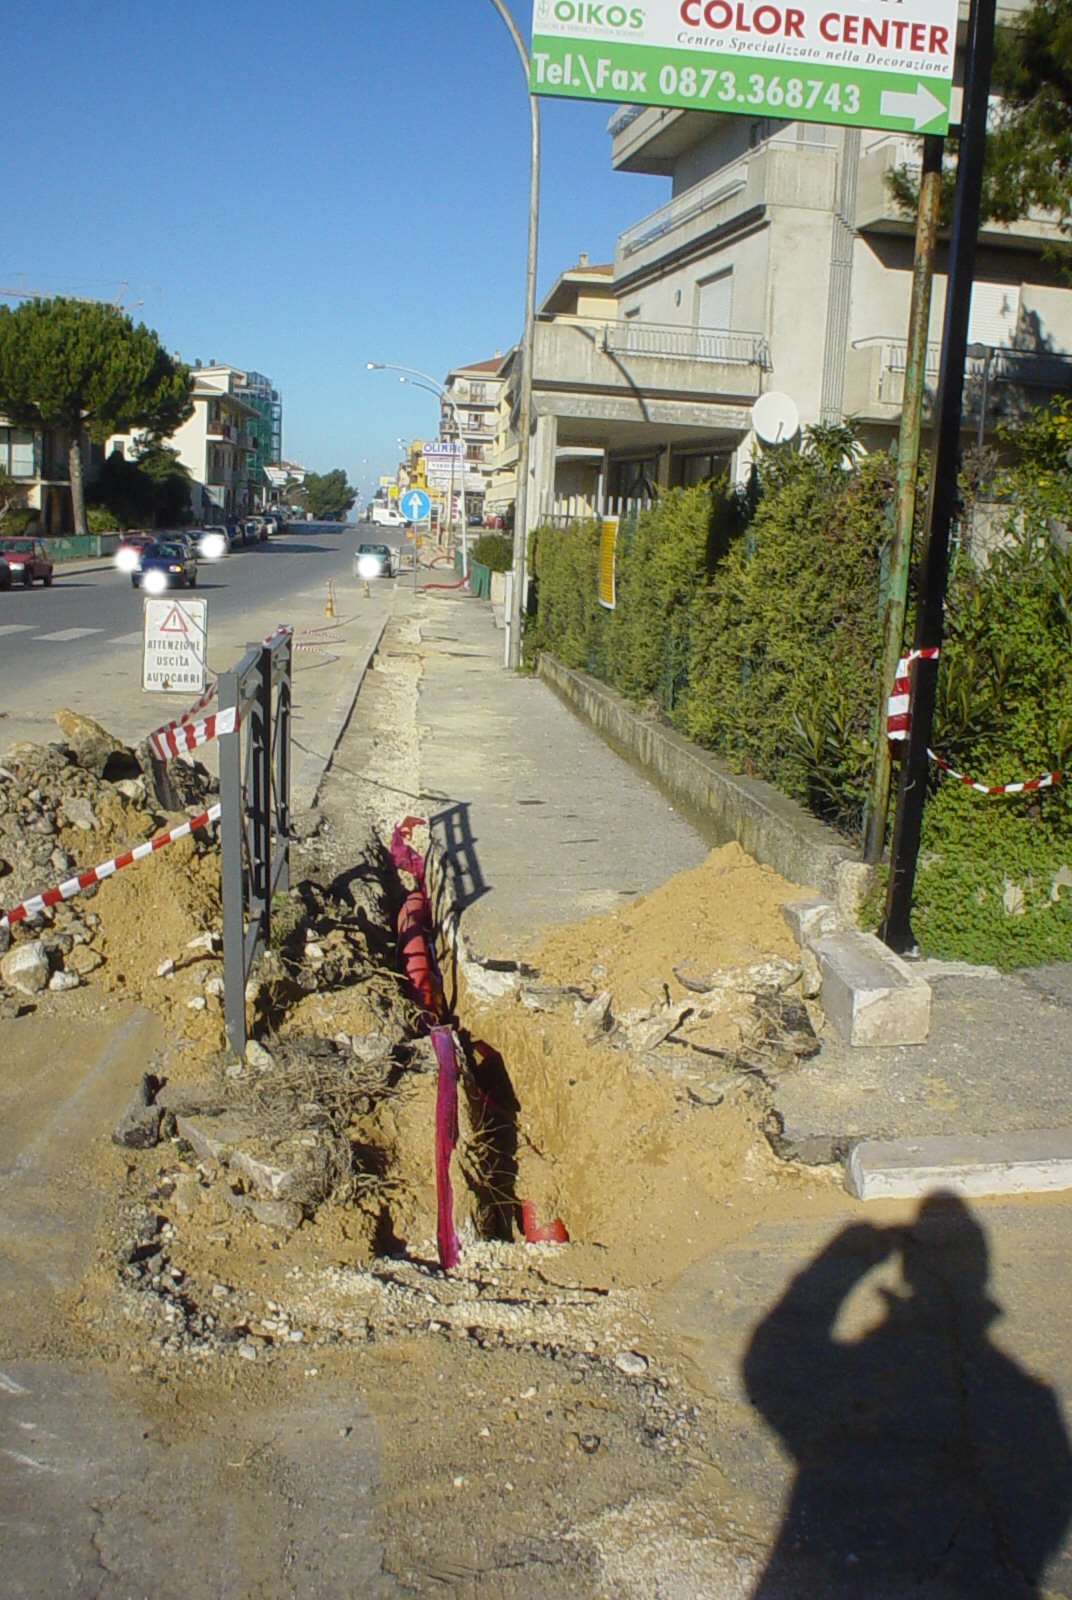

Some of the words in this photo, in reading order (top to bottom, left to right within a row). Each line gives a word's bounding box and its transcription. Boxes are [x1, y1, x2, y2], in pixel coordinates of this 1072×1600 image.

[554, 1, 644, 29] OIKOS
[680, 0, 805, 38] COLOR
[819, 12, 949, 55] CENTER
[677, 32, 724, 47] Centro
[729, 37, 821, 58] Specializzato
[825, 49, 860, 63] nella
[865, 52, 950, 73] Decorazione
[659, 65, 861, 114] 0873.368743
[147, 640, 200, 650] ATTENZIONE
[156, 655, 189, 666] USCITA
[147, 673, 199, 683] AUTOCARRI
